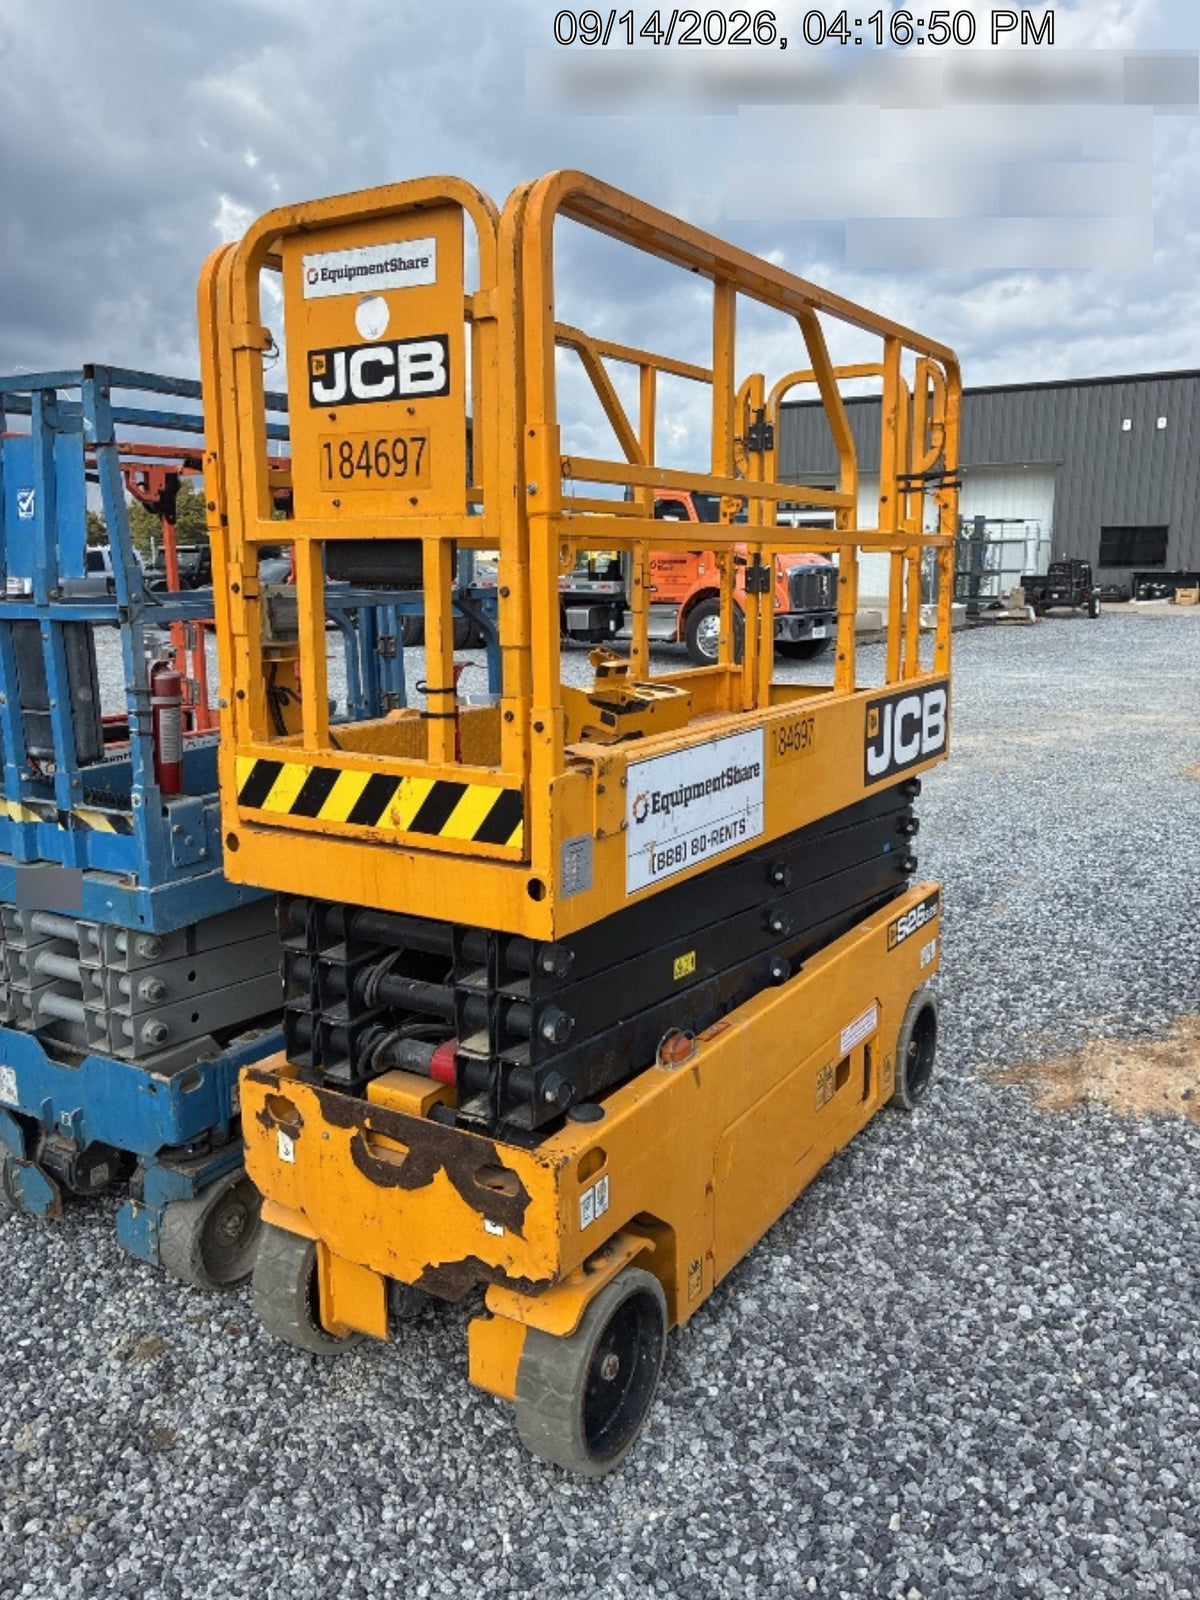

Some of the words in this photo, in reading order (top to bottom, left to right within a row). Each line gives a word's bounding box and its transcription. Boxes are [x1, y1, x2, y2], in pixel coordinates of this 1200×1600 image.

[321, 257, 429, 283] EquipmentShare
[312, 340, 447, 402] JCB
[323, 436, 427, 481] 184697
[867, 689, 947, 776] JCB
[652, 762, 760, 815] EquipmentShare
[691, 818, 746, 856] 80-RENTS
